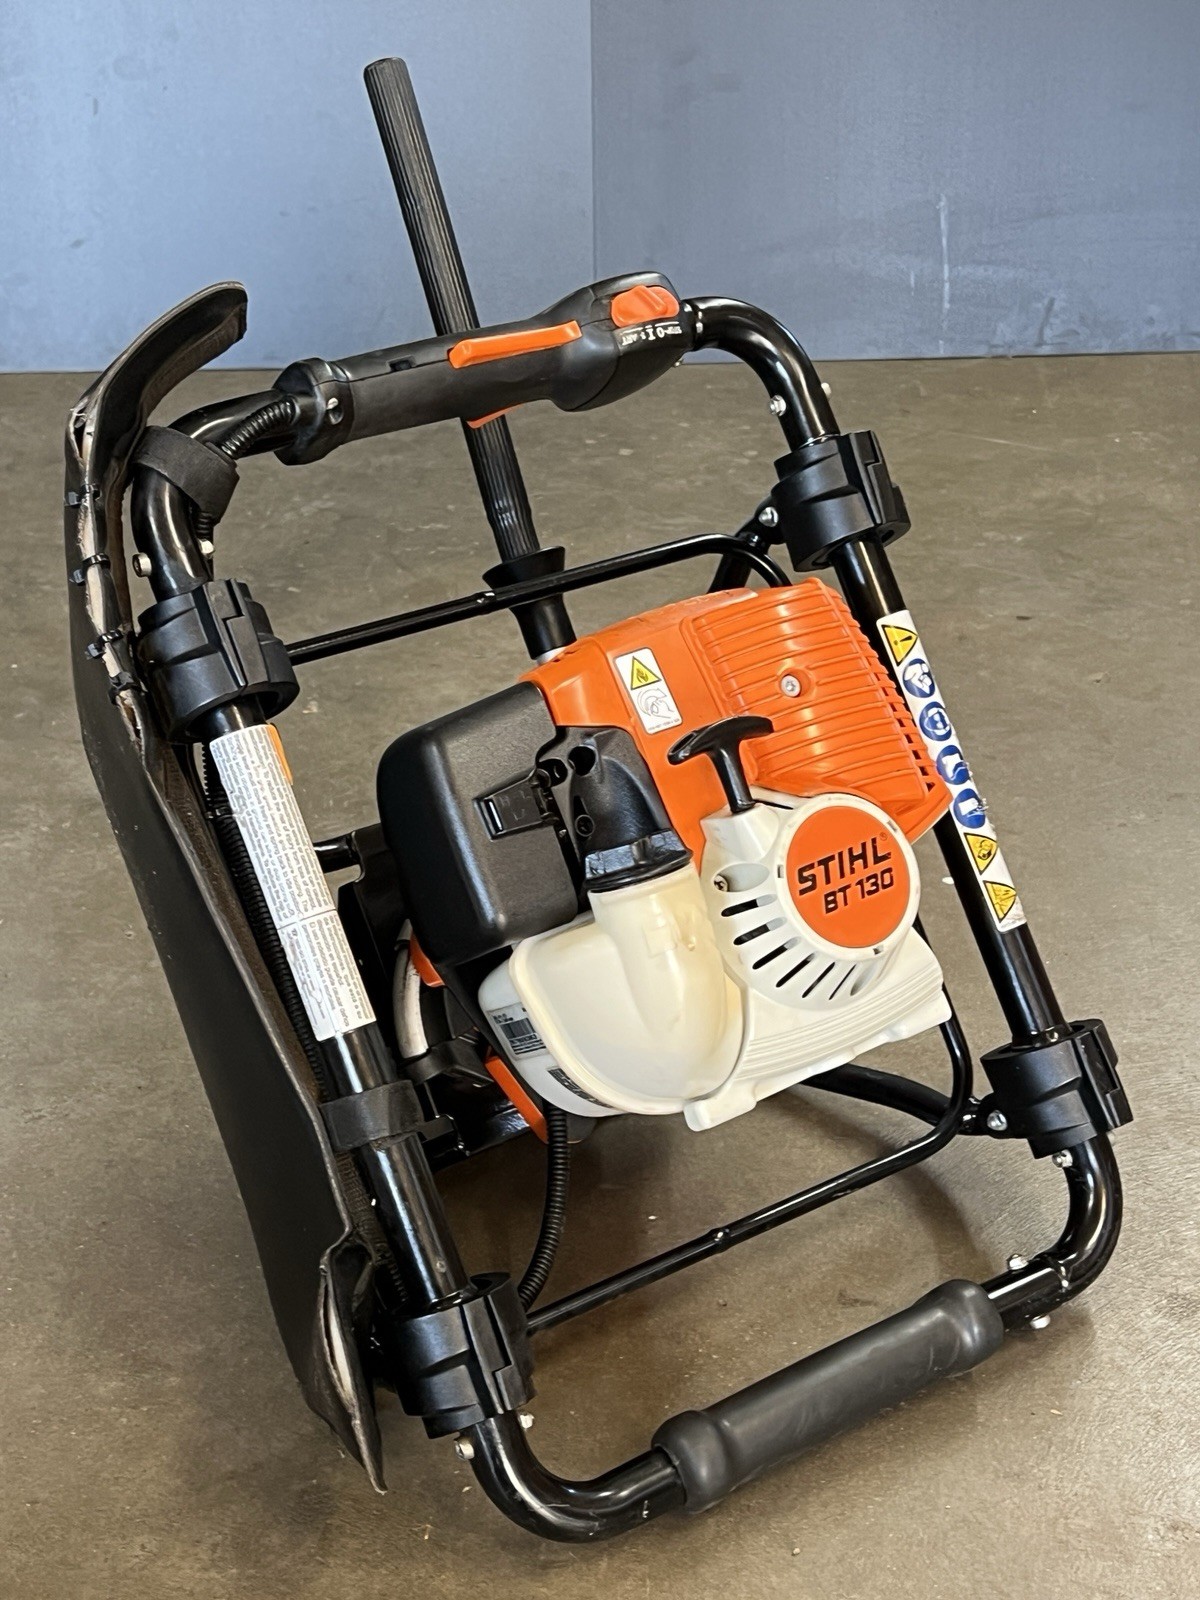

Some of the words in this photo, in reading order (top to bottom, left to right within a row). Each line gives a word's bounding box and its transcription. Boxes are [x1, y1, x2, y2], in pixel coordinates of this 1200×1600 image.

[797, 836, 892, 897] STIHL
[823, 883, 852, 914] BT
[855, 867, 894, 899] 130
